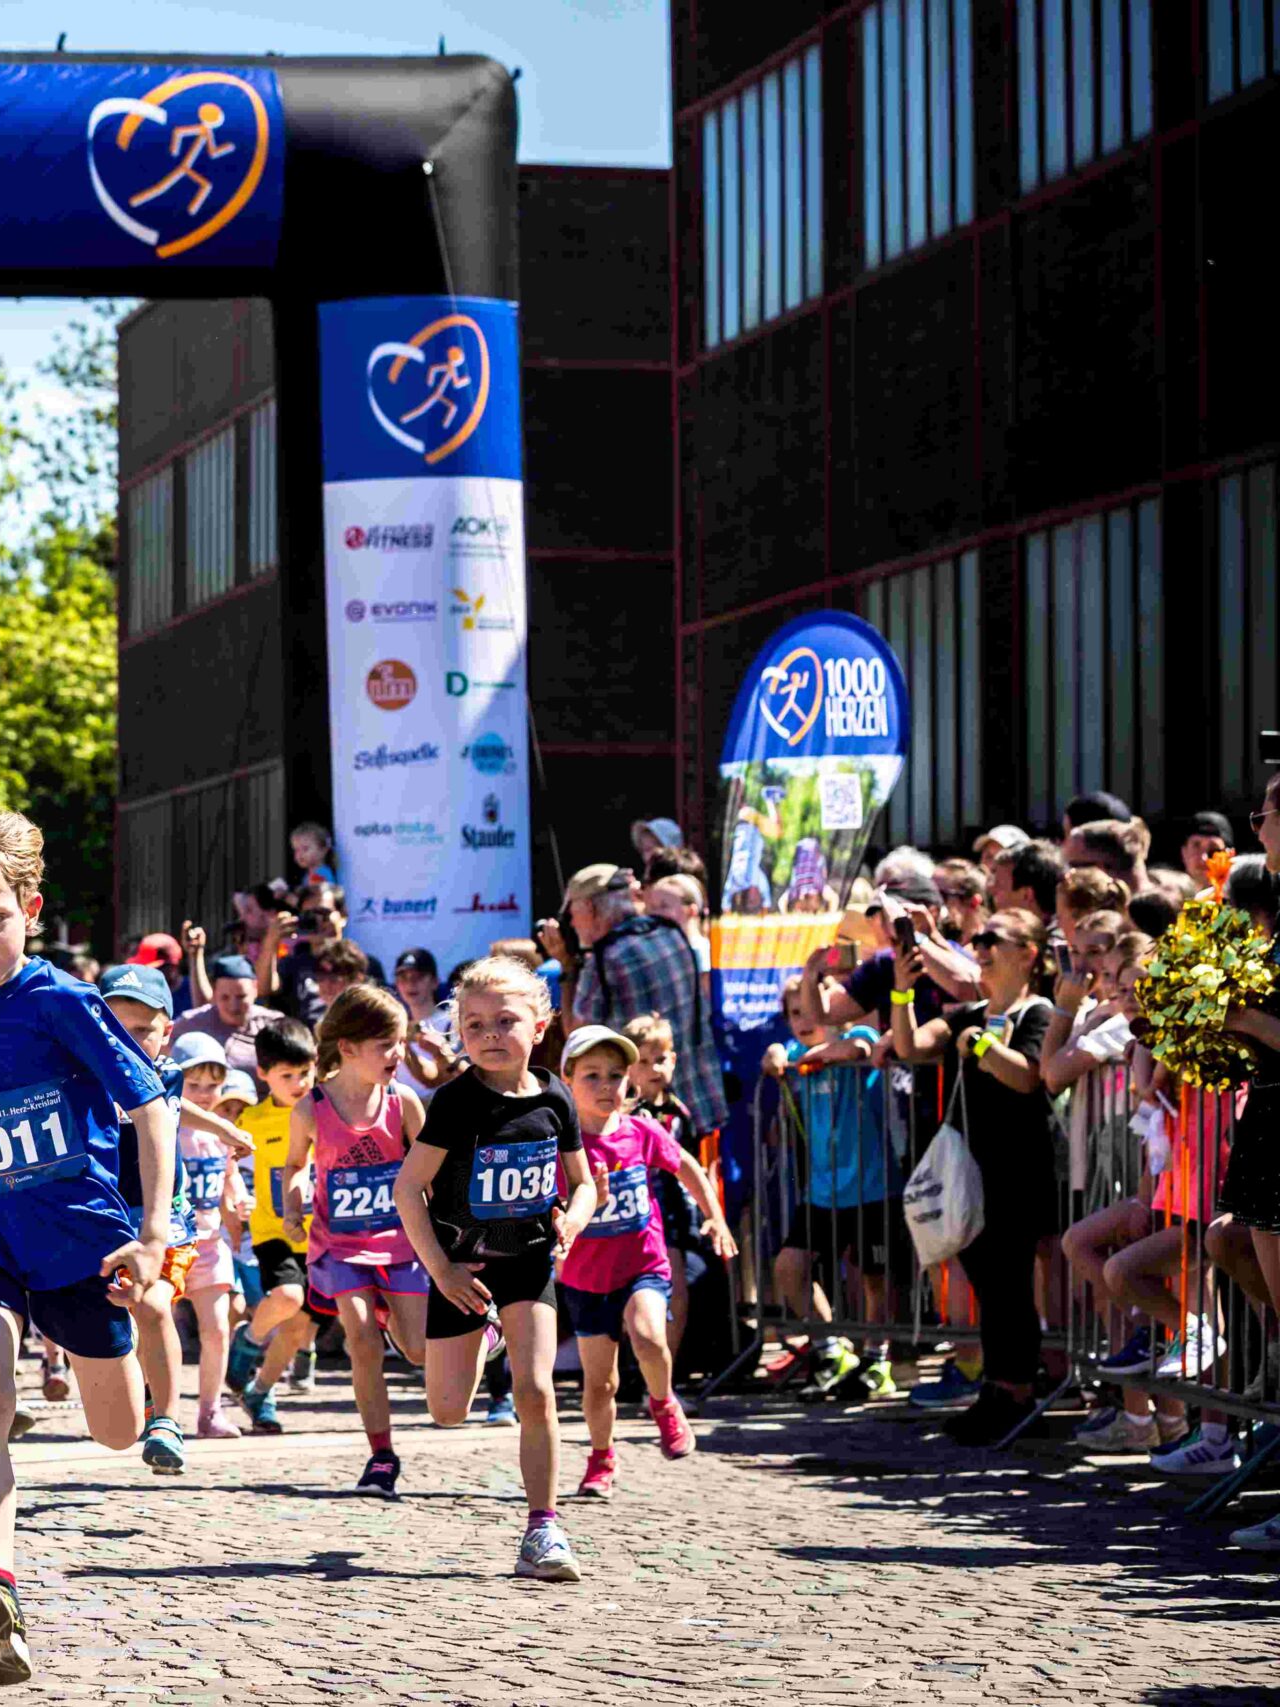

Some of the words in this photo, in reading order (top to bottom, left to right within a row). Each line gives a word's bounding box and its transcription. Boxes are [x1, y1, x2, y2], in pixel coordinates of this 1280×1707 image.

[824, 657, 886, 697] 1000
[824, 695, 889, 737] HERZEN
[9, 1095, 61, 1115] Herz-Kreislauf
[34, 1094, 45, 1102] Mai
[46, 1089, 60, 1098] 2025
[477, 1161, 557, 1202] 1038
[590, 1184, 650, 1223] 238
